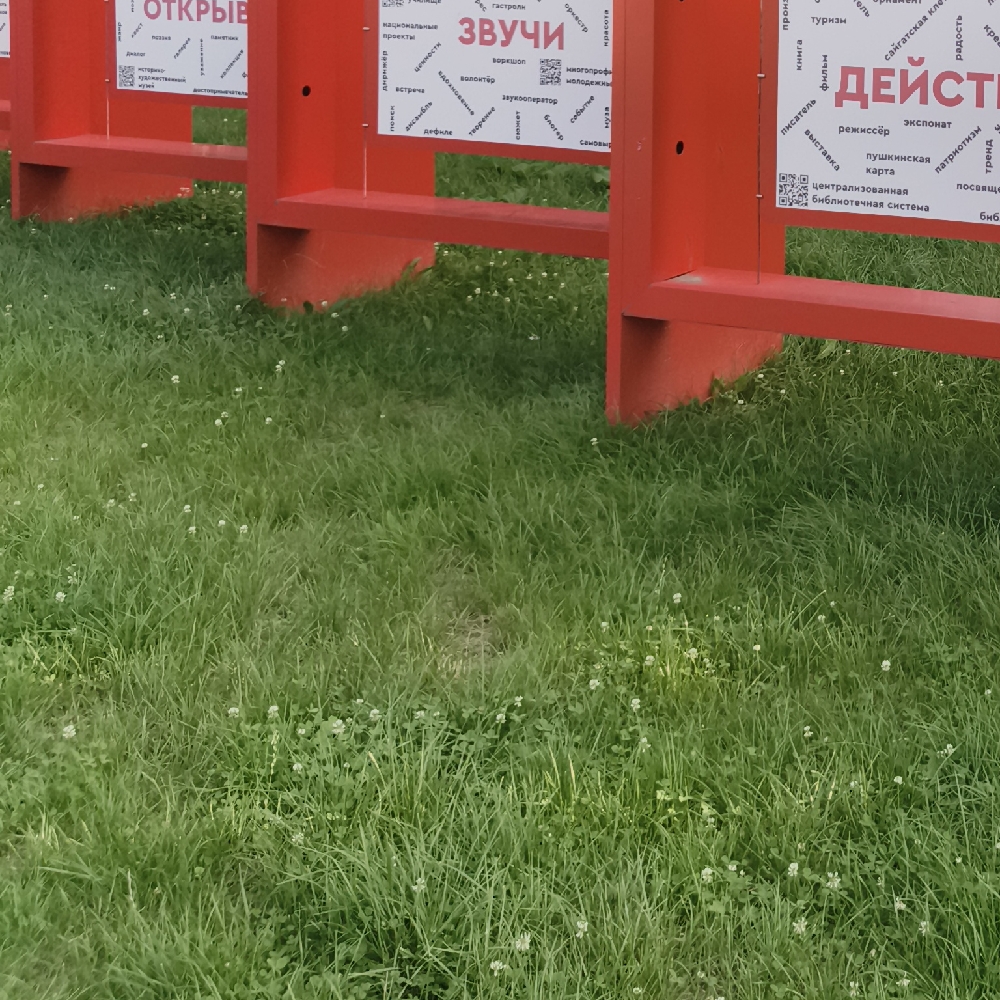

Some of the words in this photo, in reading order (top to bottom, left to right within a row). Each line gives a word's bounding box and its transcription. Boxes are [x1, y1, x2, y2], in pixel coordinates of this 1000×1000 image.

[382, 22, 438, 30] национальные
[564, 3, 588, 33] оркестр
[811, 16, 846, 26] туризм
[458, 17, 564, 50] ЗВУЧИ
[885, 15, 928, 61] сайгатская
[956, 15, 964, 61] радость
[460, 76, 496, 84] волонтёр
[819, 54, 830, 92] фильм
[395, 86, 425, 94] встреча
[780, 100, 816, 136] писатель
[904, 119, 952, 128] экспонат
[423, 128, 452, 136] дефиле
[544, 114, 564, 141] блогер
[838, 125, 890, 137] режиссёр
[804, 129, 840, 172] выставка
[866, 153, 931, 164] пушкинская
[934, 126, 982, 174] патриотизм
[985, 139, 994, 174] тренд
[866, 167, 895, 176] карта
[812, 182, 908, 196] централизованная
[812, 194, 884, 208] библиотечная
[887, 202, 930, 212] система
